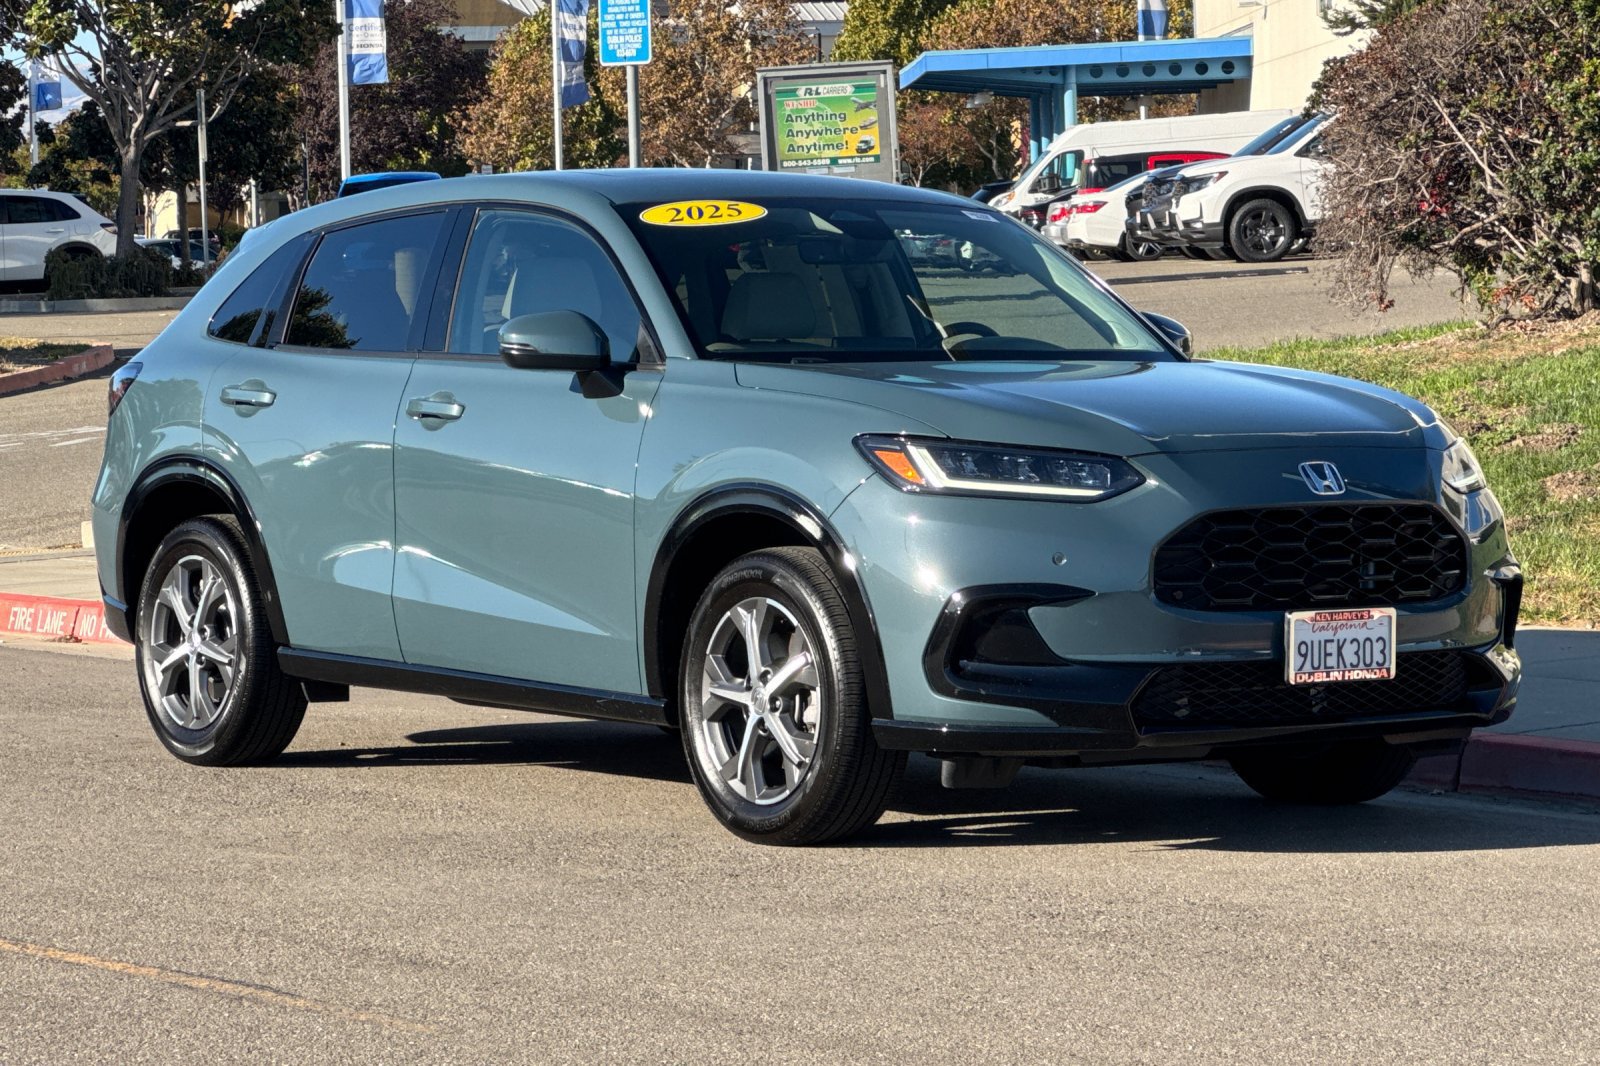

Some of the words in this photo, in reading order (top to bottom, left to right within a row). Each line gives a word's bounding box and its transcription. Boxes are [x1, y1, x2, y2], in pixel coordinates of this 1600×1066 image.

[625, 34, 642, 42] POLICE
[823, 85, 848, 94] CARRIERS
[786, 112, 846, 124] Anything
[786, 126, 858, 139] Anywhere
[787, 140, 848, 154] Anytime!
[665, 204, 742, 222] 2025
[8, 606, 34, 632] FIRE
[36, 610, 67, 634] LANE
[80, 614, 96, 636] NO
[1316, 613, 1331, 621] KEN
[1332, 611, 1370, 620] HARVEY'S
[1312, 622, 1374, 636] California
[1297, 636, 1386, 671] 9UEK303
[1296, 671, 1342, 682] DUBLIN
[1344, 669, 1388, 680] HONDA
